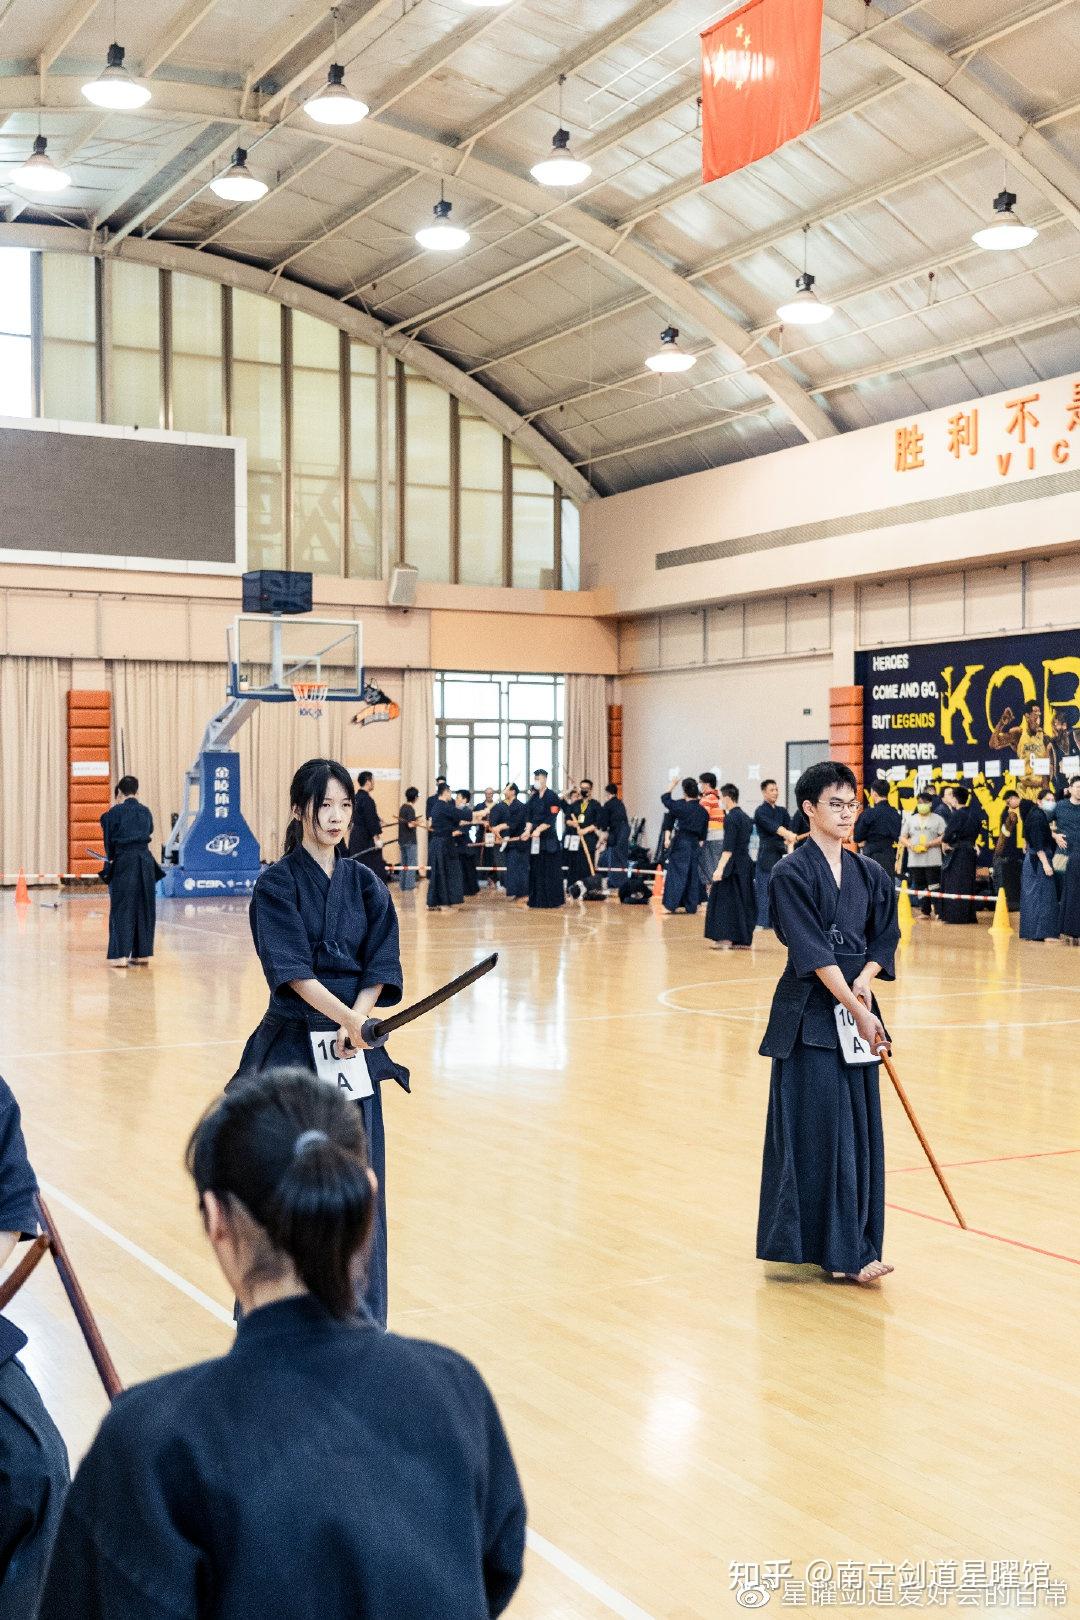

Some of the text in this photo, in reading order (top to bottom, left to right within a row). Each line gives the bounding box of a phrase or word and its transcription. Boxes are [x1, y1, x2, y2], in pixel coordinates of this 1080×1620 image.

[872, 653, 909, 671] HEROES
[872, 681, 939, 700] COME AND GO,
[872, 712, 935, 729] BUT LEGENDS
[870, 743, 938, 760] ARE FOREVER.
[853, 1036, 866, 1054] A
[337, 1072, 354, 1092] A
